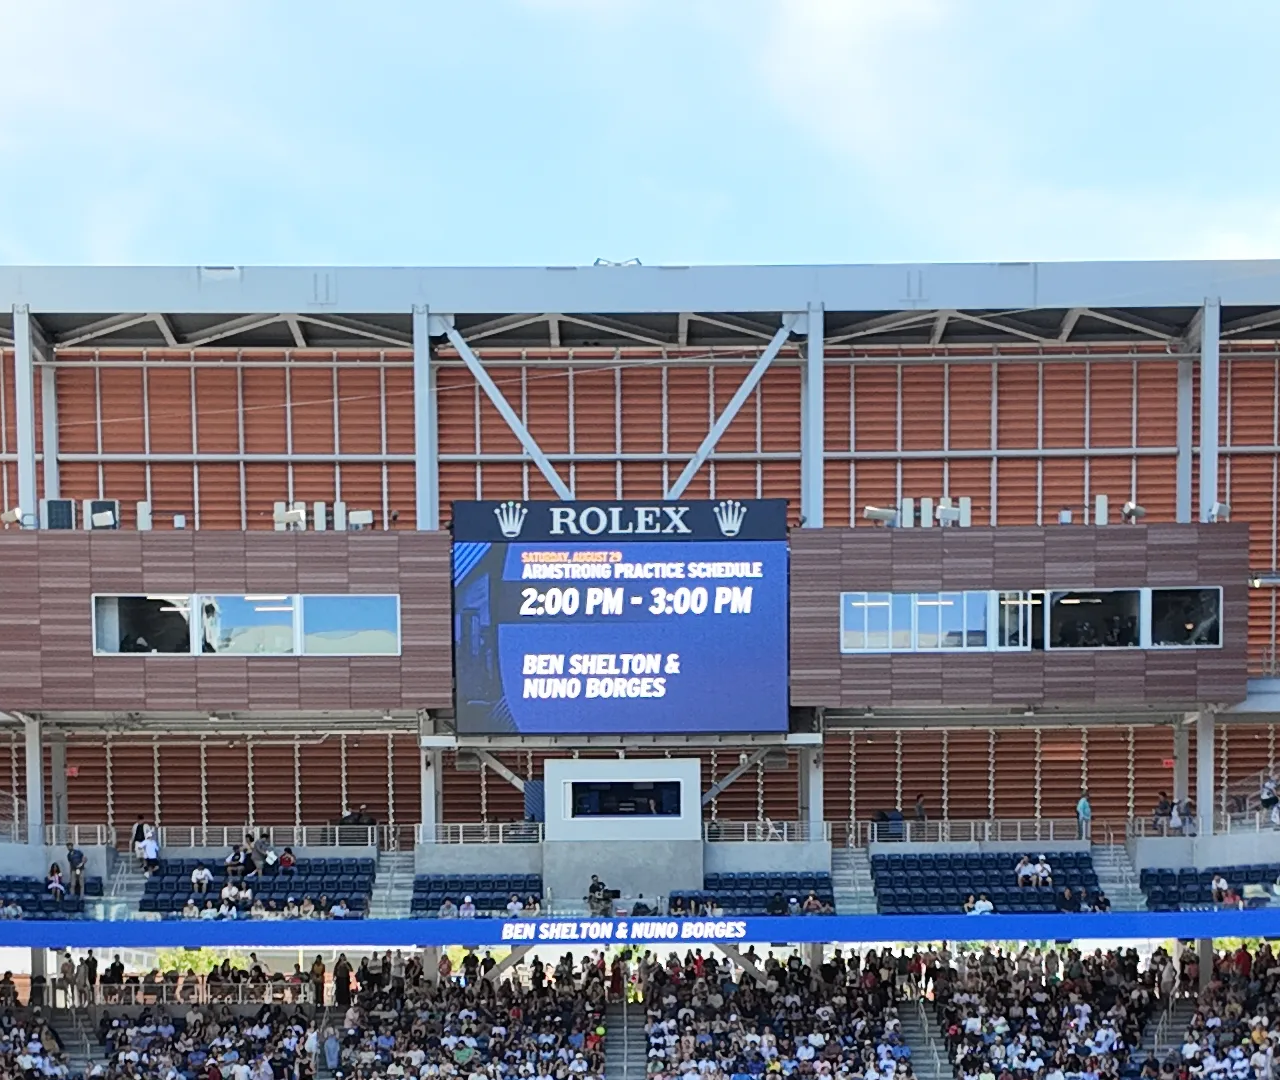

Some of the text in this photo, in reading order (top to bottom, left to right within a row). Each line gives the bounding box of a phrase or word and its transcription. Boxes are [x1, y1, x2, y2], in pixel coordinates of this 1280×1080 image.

[549, 507, 692, 534] ROLEX
[521, 551, 571, 565] SATURDAY,
[571, 551, 608, 563] AUGUST
[522, 562, 764, 580] ARMSTRONG PRACTICE SCHEDULE
[519, 586, 754, 616] 2:00 PM - 3:00 PM
[522, 653, 681, 675] BEN SHELTON &
[522, 677, 667, 698] NUNO BORGES
[502, 921, 746, 940] BEN SHELTON & NUNO BORGES
